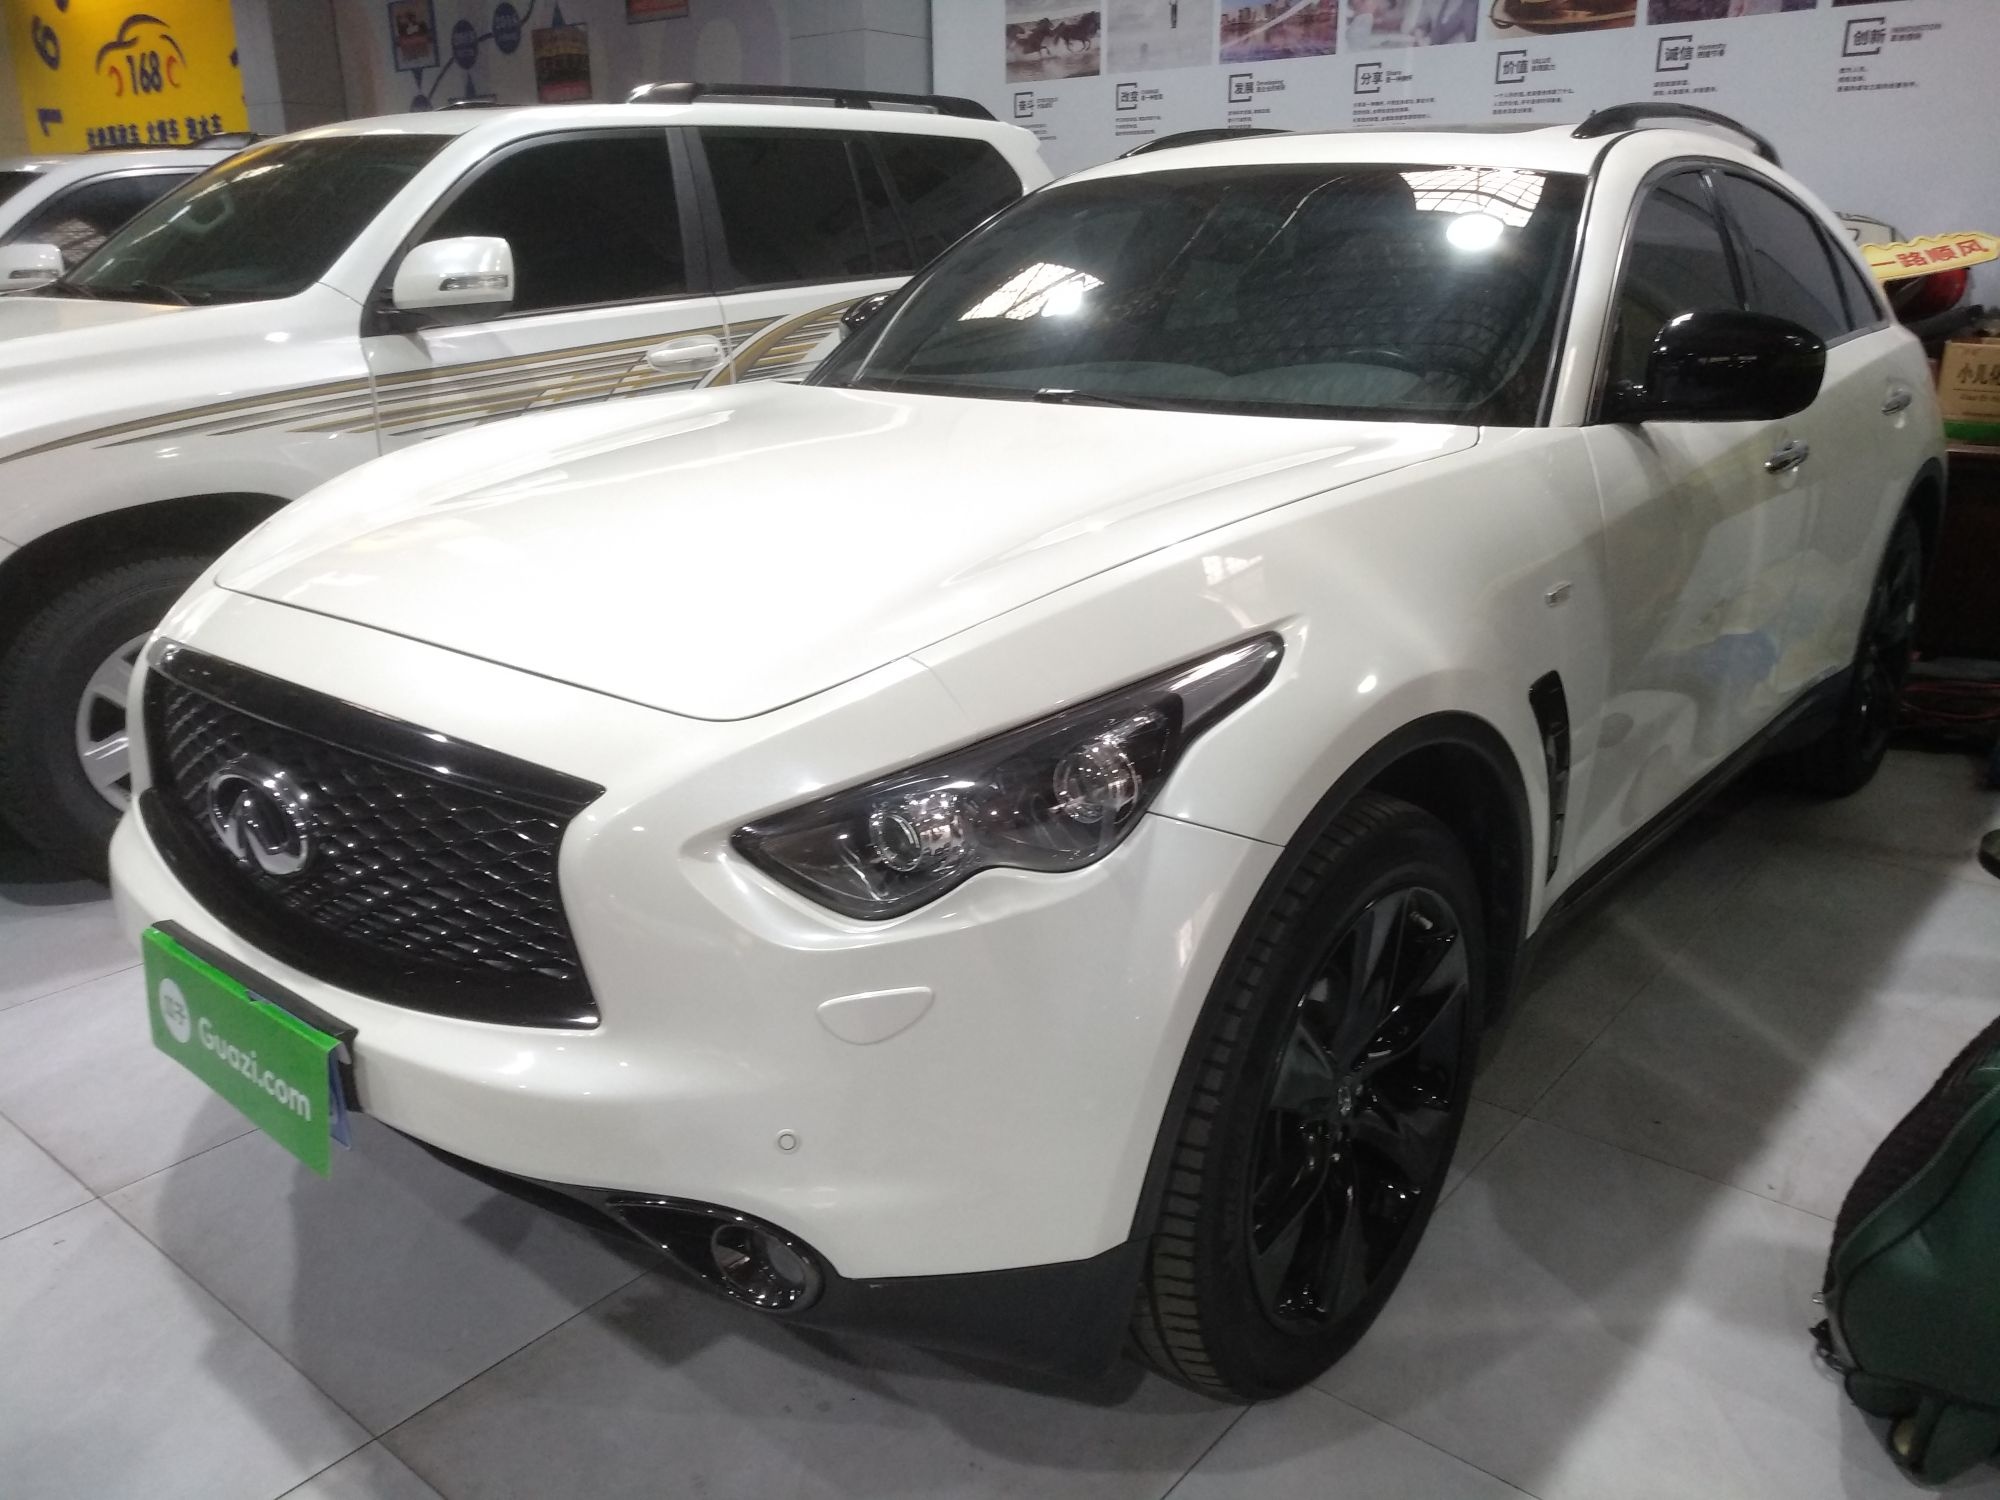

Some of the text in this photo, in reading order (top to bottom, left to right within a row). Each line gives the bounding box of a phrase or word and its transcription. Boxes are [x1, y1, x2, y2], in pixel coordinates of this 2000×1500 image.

[1853, 28, 1887, 46] 创新
[1665, 46, 1694, 61] 诚信
[126, 50, 163, 96] 168
[1503, 60, 1528, 75] 价值
[1360, 71, 1383, 85] 分享
[1234, 82, 1254, 94] 发展
[1120, 90, 1139, 103] 改变
[1871, 238, 1990, 268] 一路顺风
[198, 1016, 312, 1122] Guazi.com
